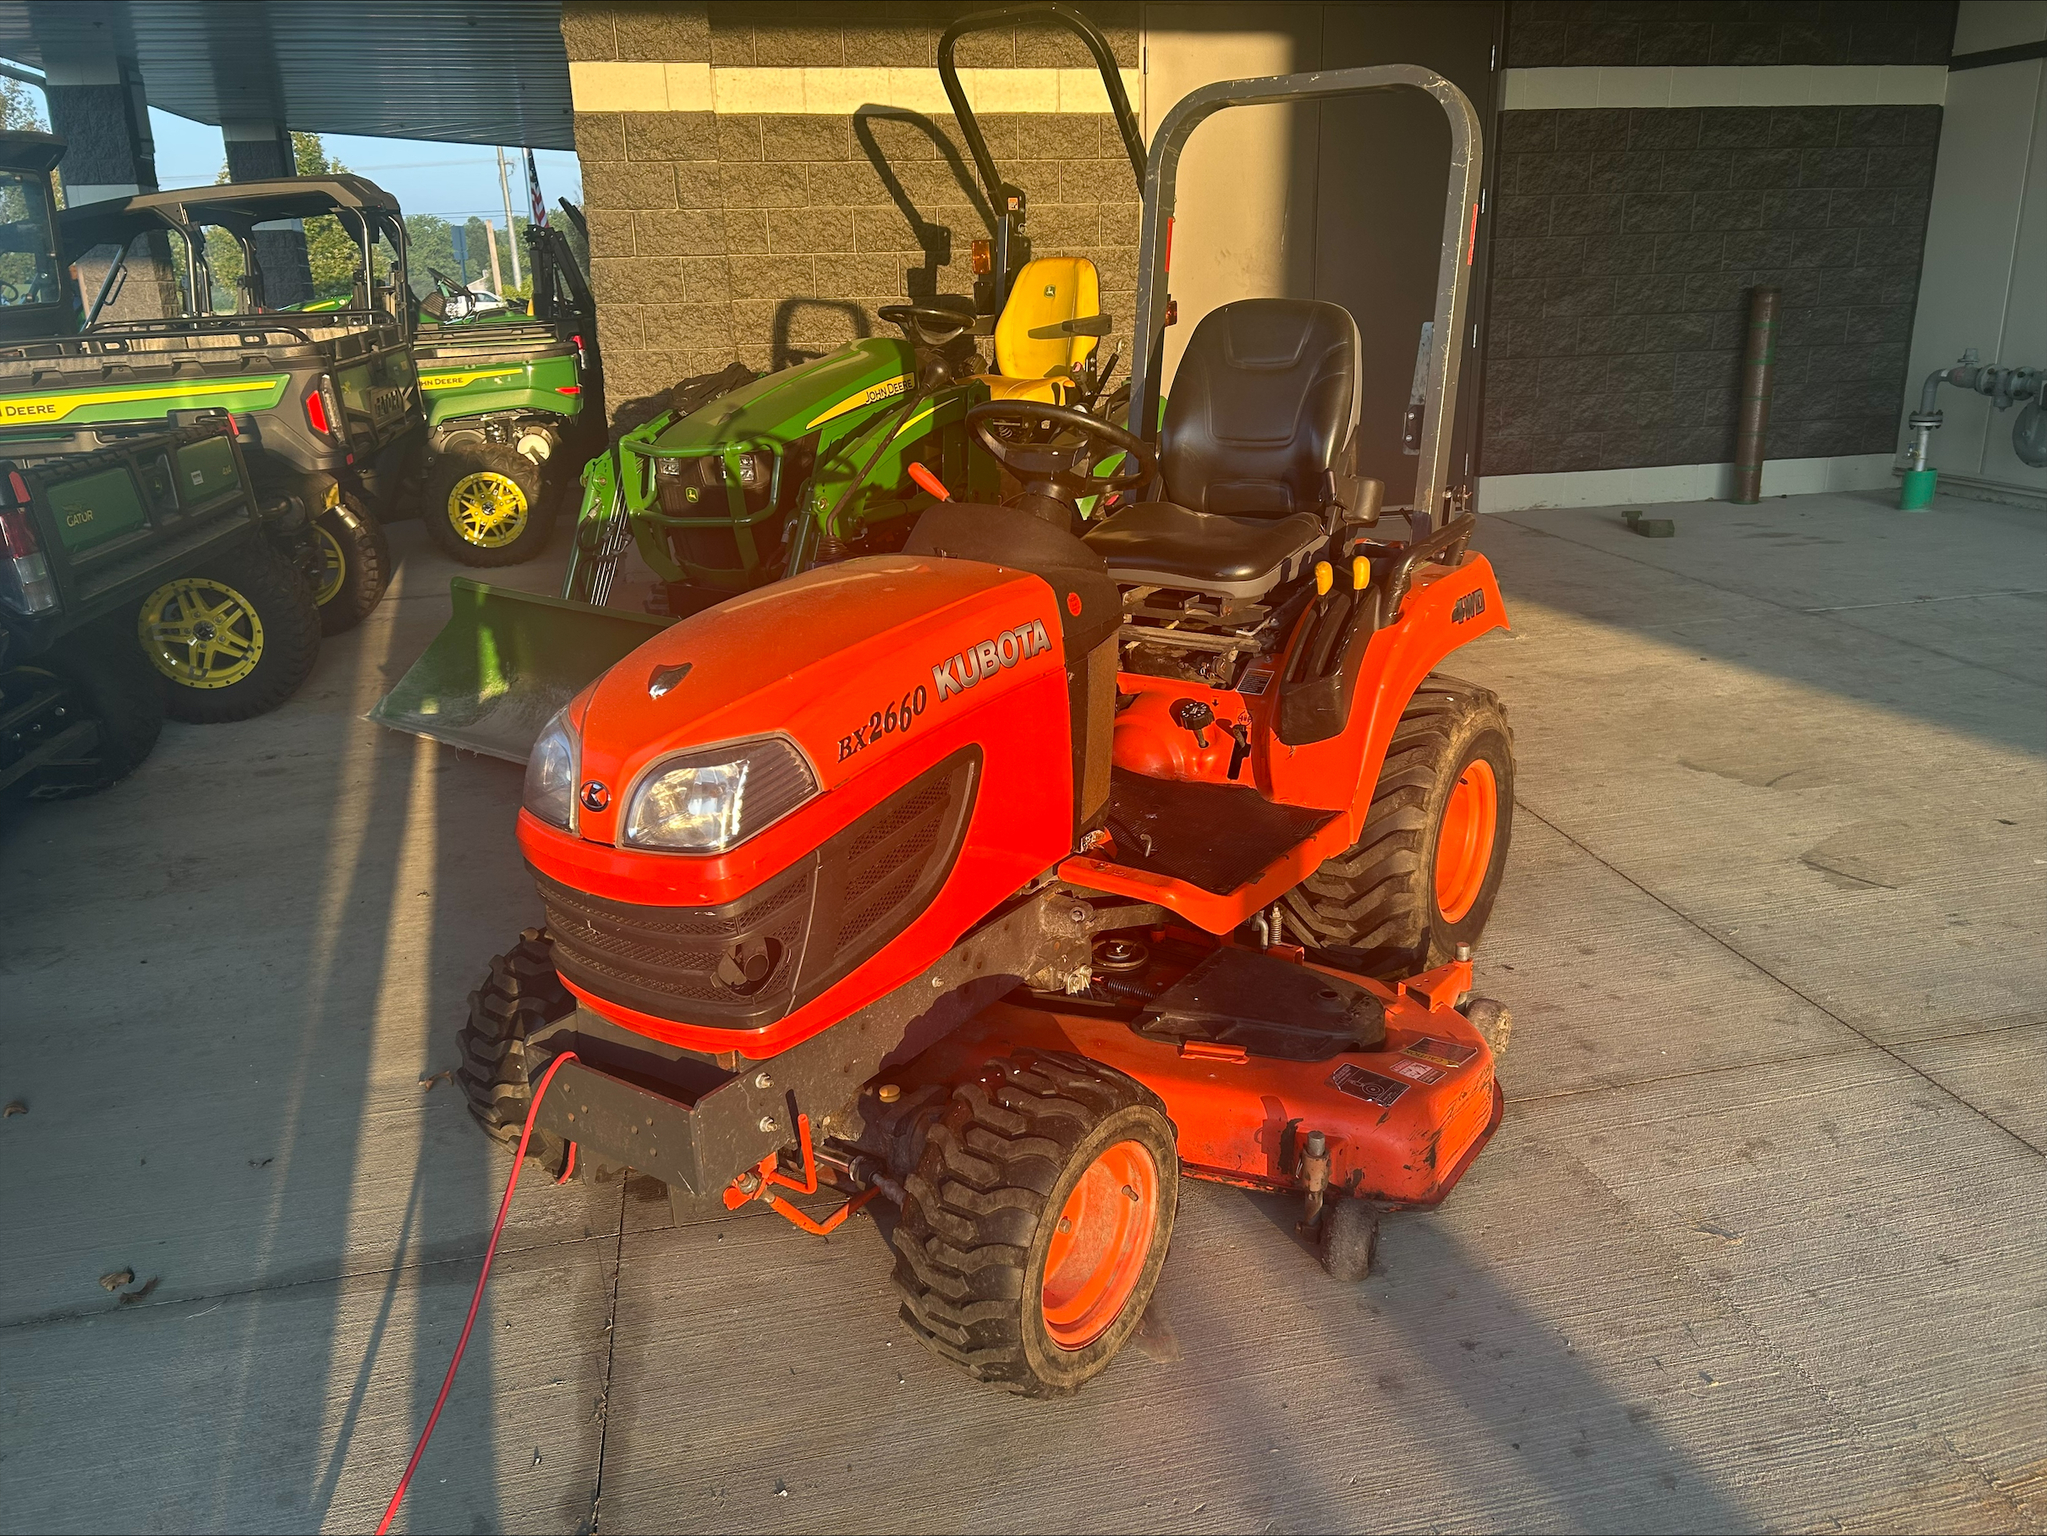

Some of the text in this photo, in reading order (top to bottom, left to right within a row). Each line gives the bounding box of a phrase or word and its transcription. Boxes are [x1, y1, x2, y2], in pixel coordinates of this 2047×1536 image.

[434, 378, 463, 386] DEERE
[865, 378, 913, 403] JOHN DEERE
[5, 404, 56, 417] DEERE
[66, 509, 94, 528] GATOR
[1451, 587, 1486, 625] 4WD
[931, 618, 1052, 703] KUBOTA
[837, 684, 927, 764] BX2660
